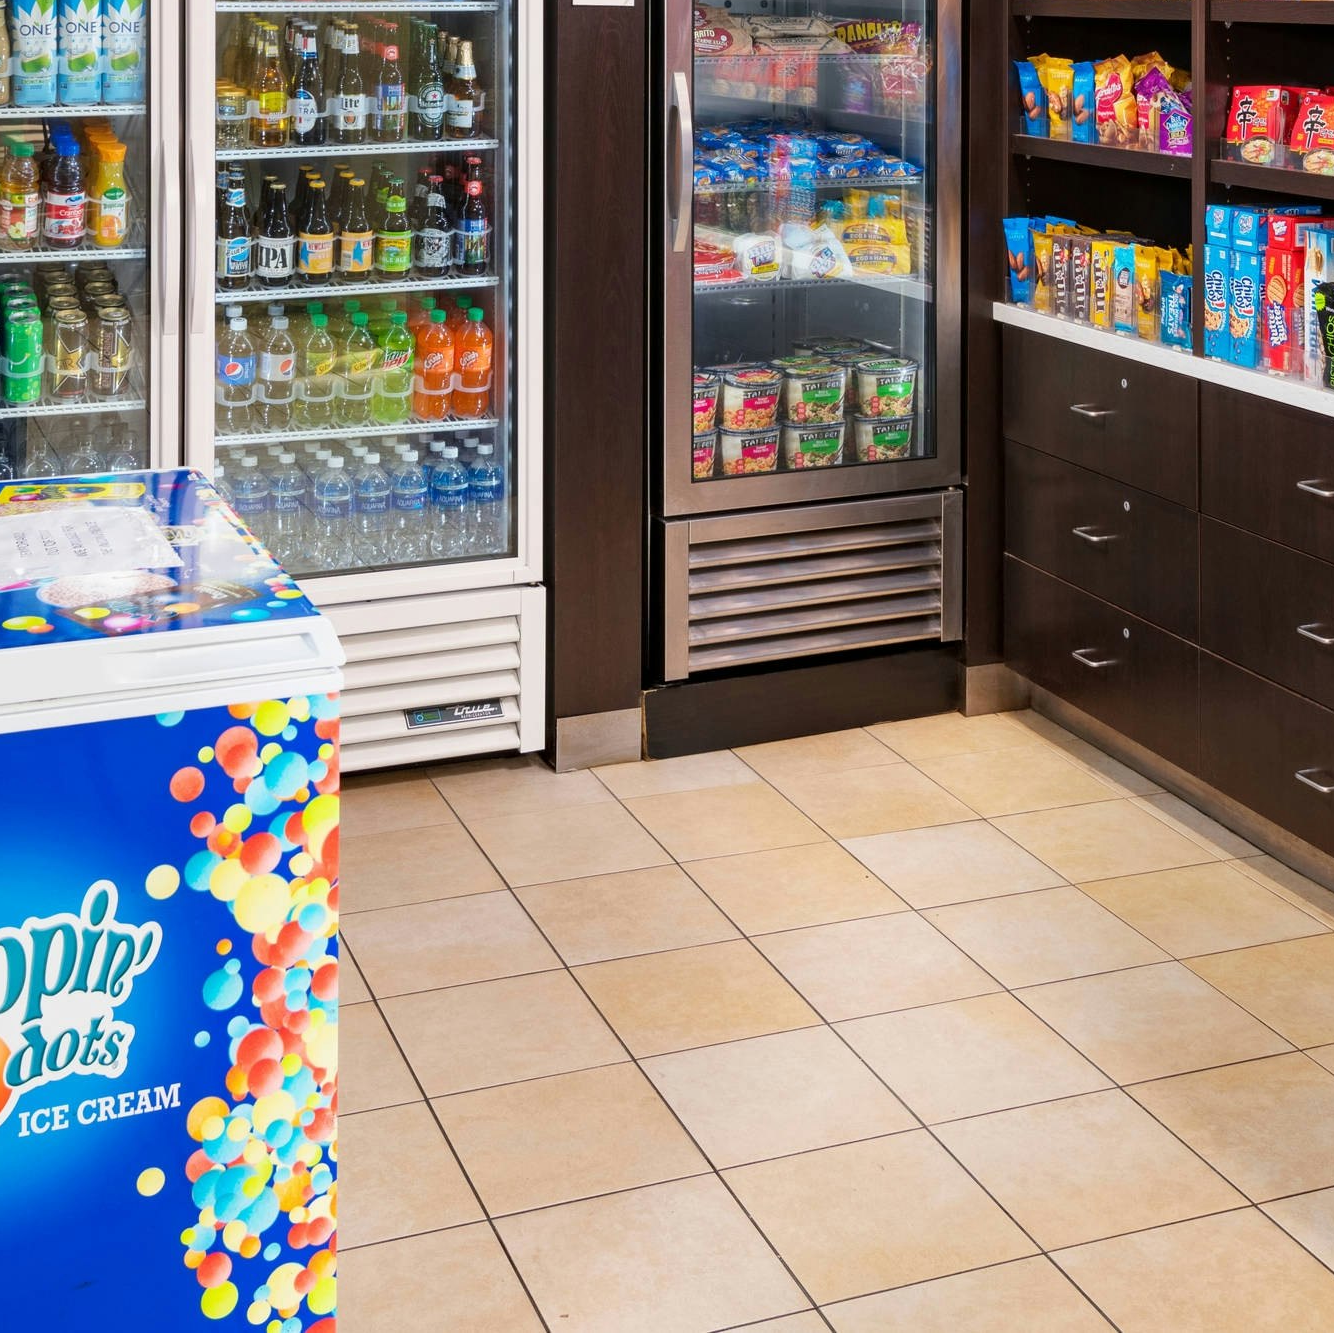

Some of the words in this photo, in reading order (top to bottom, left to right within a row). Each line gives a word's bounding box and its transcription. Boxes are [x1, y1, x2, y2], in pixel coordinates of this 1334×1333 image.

[20, 23, 52, 36] ONE
[65, 21, 97, 34] ONE
[108, 21, 140, 34] ONE
[259, 246, 288, 269] IPA
[1212, 270, 1223, 302] Chips
[1241, 276, 1253, 311] Chips
[5, 1016, 126, 1086] dots
[18, 1105, 70, 1137] ICE
[76, 1082, 181, 1127] CREAM
